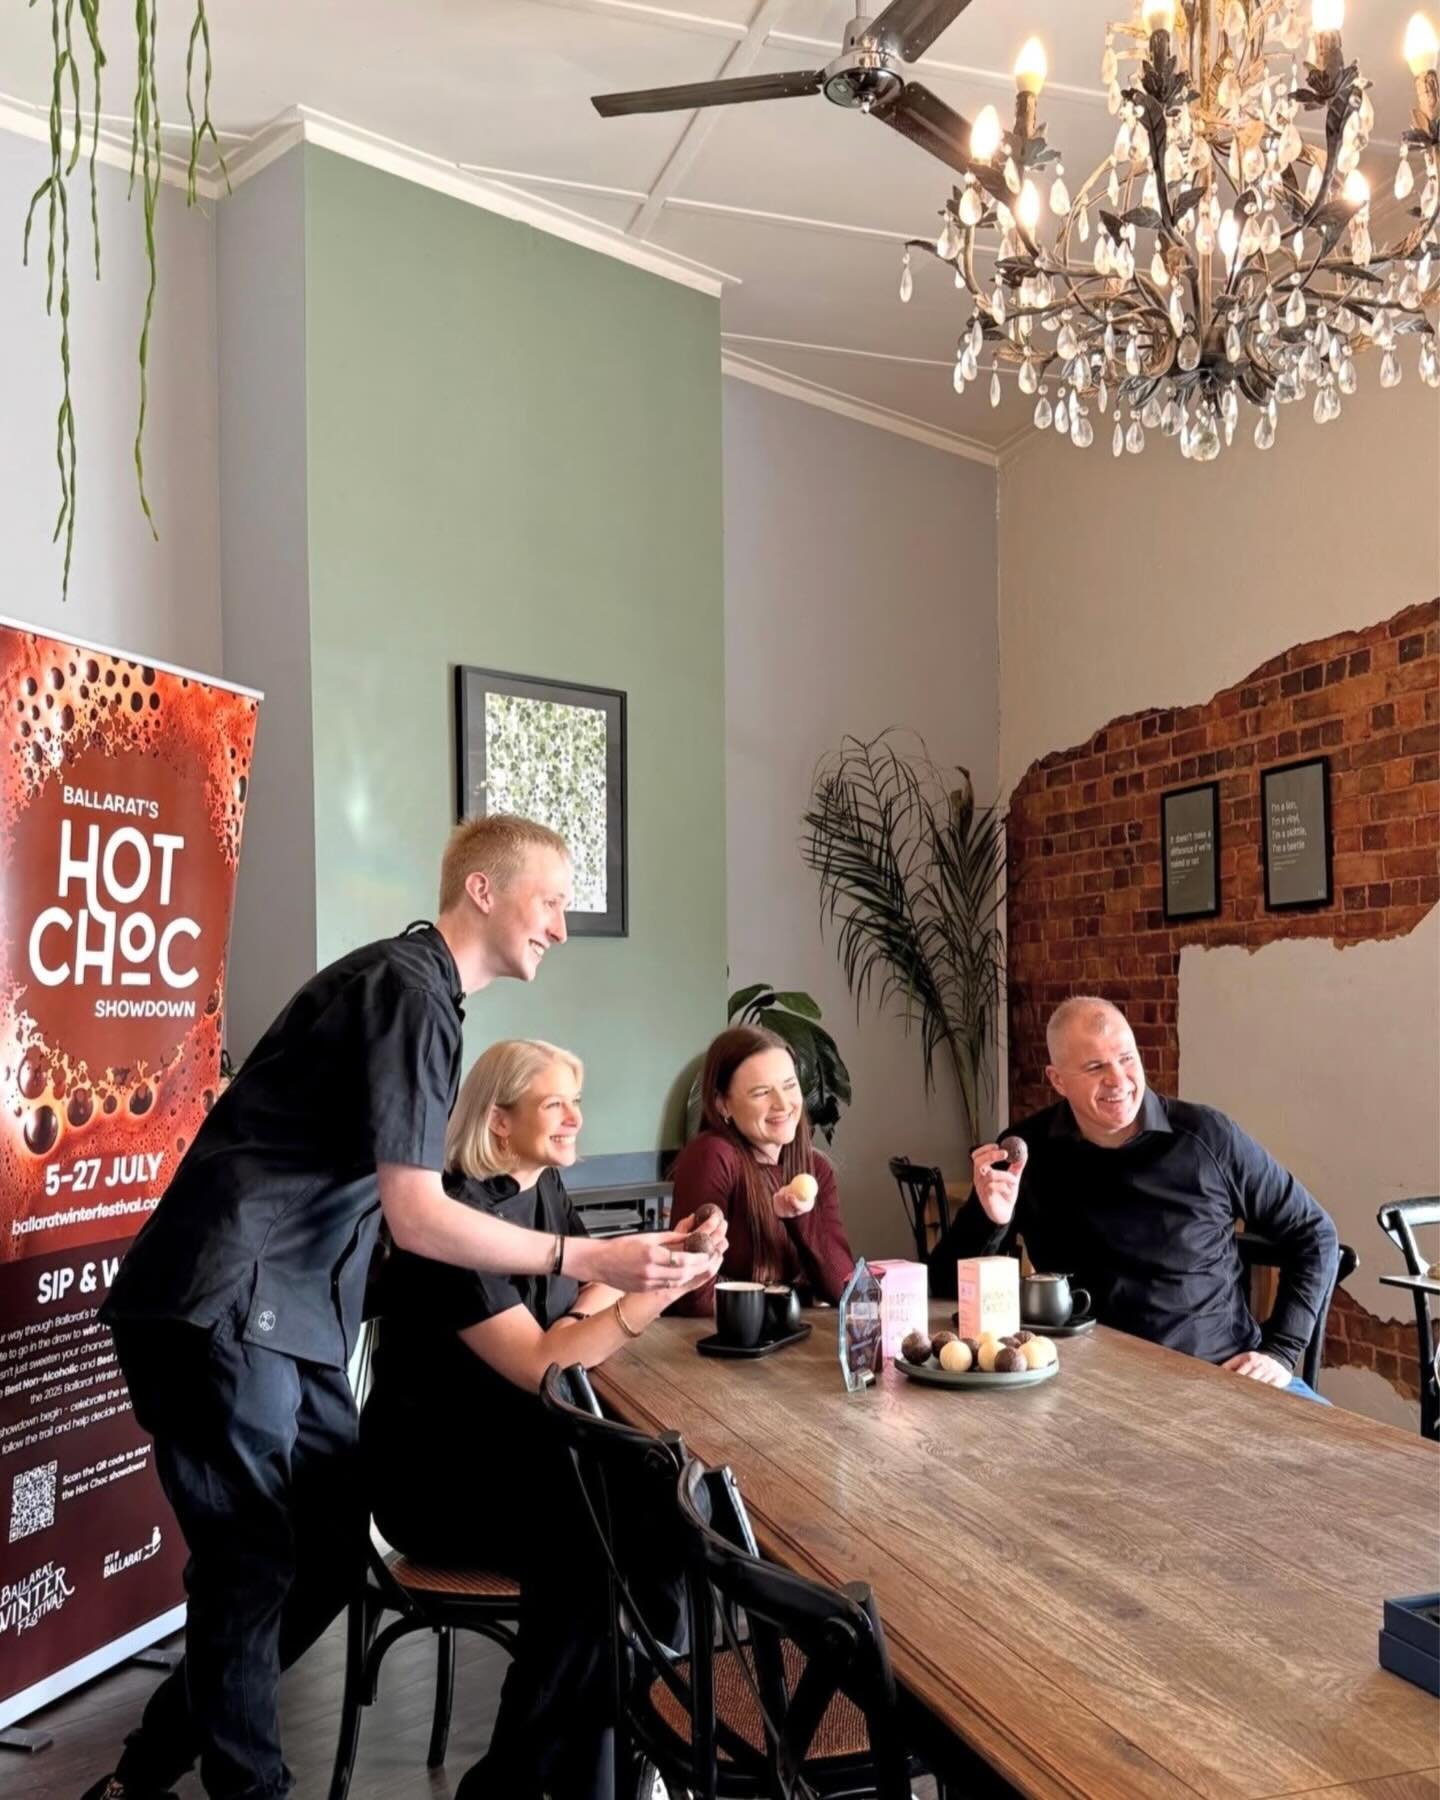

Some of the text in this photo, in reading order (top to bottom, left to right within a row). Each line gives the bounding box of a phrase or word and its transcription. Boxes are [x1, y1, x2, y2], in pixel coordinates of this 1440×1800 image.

[63, 785, 160, 819] BALLARAT'S
[58, 819, 184, 911] HOT
[94, 999, 196, 1018] SHOWDOWN
[45, 1152, 165, 1196] 5-27 JULY
[11, 1197, 161, 1235] ballaratwinterfestival.co
[37, 1256, 120, 1304] SIP & W
[8, 1328, 23, 1341] way
[25, 1318, 54, 1336] through
[55, 1309, 89, 1327] Ballarat's
[9, 1348, 16, 1359] to
[18, 1345, 28, 1359] go
[30, 1341, 37, 1352] in
[38, 1337, 50, 1349] the
[52, 1331, 72, 1345] draw
[73, 1329, 82, 1339] to
[4, 1381, 21, 1396] Best
[23, 1363, 79, 1390] Non-Alcoholic
[80, 1358, 96, 1371] and
[97, 1352, 114, 1366] Best
[15, 1361, 28, 1378] just
[29, 1353, 60, 1369] sweeten
[62, 1346, 79, 1362] your
[30, 1393, 43, 1405] the
[44, 1384, 63, 1400] 2025
[64, 1376, 94, 1393] Ballarat
[94, 1368, 118, 1384] Winter
[0, 1415, 39, 1438] showdown
[40, 1407, 63, 1422] begin
[70, 1393, 107, 1412] celebrate
[107, 1388, 119, 1400] the
[2, 1400, 133, 1455] follow the trail and help decide who
[62, 1443, 151, 1485] Scan the QR code to start
[61, 1489, 75, 1501] the
[75, 1482, 89, 1495] Hot
[89, 1475, 108, 1489] Choc
[0, 1560, 54, 1607] BALLARAT
[103, 1549, 143, 1579] BALLARAT
[17, 1590, 66, 1637] FESTIVAL
